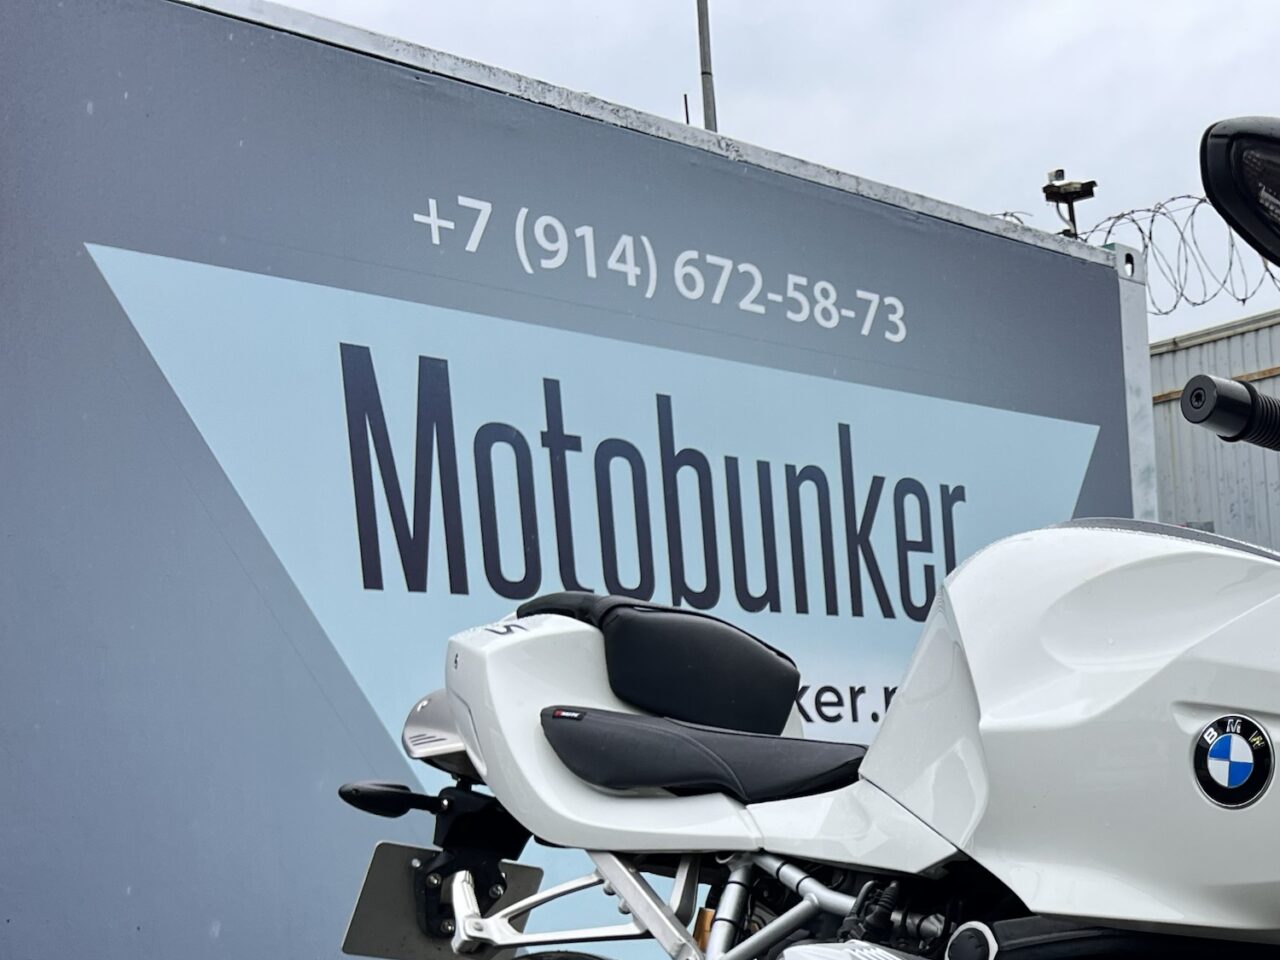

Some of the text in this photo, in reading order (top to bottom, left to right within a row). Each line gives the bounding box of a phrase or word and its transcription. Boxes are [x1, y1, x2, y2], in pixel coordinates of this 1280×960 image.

[413, 195, 907, 343] +7 (914) 672-58-73
[339, 342, 967, 622] Motobunker
